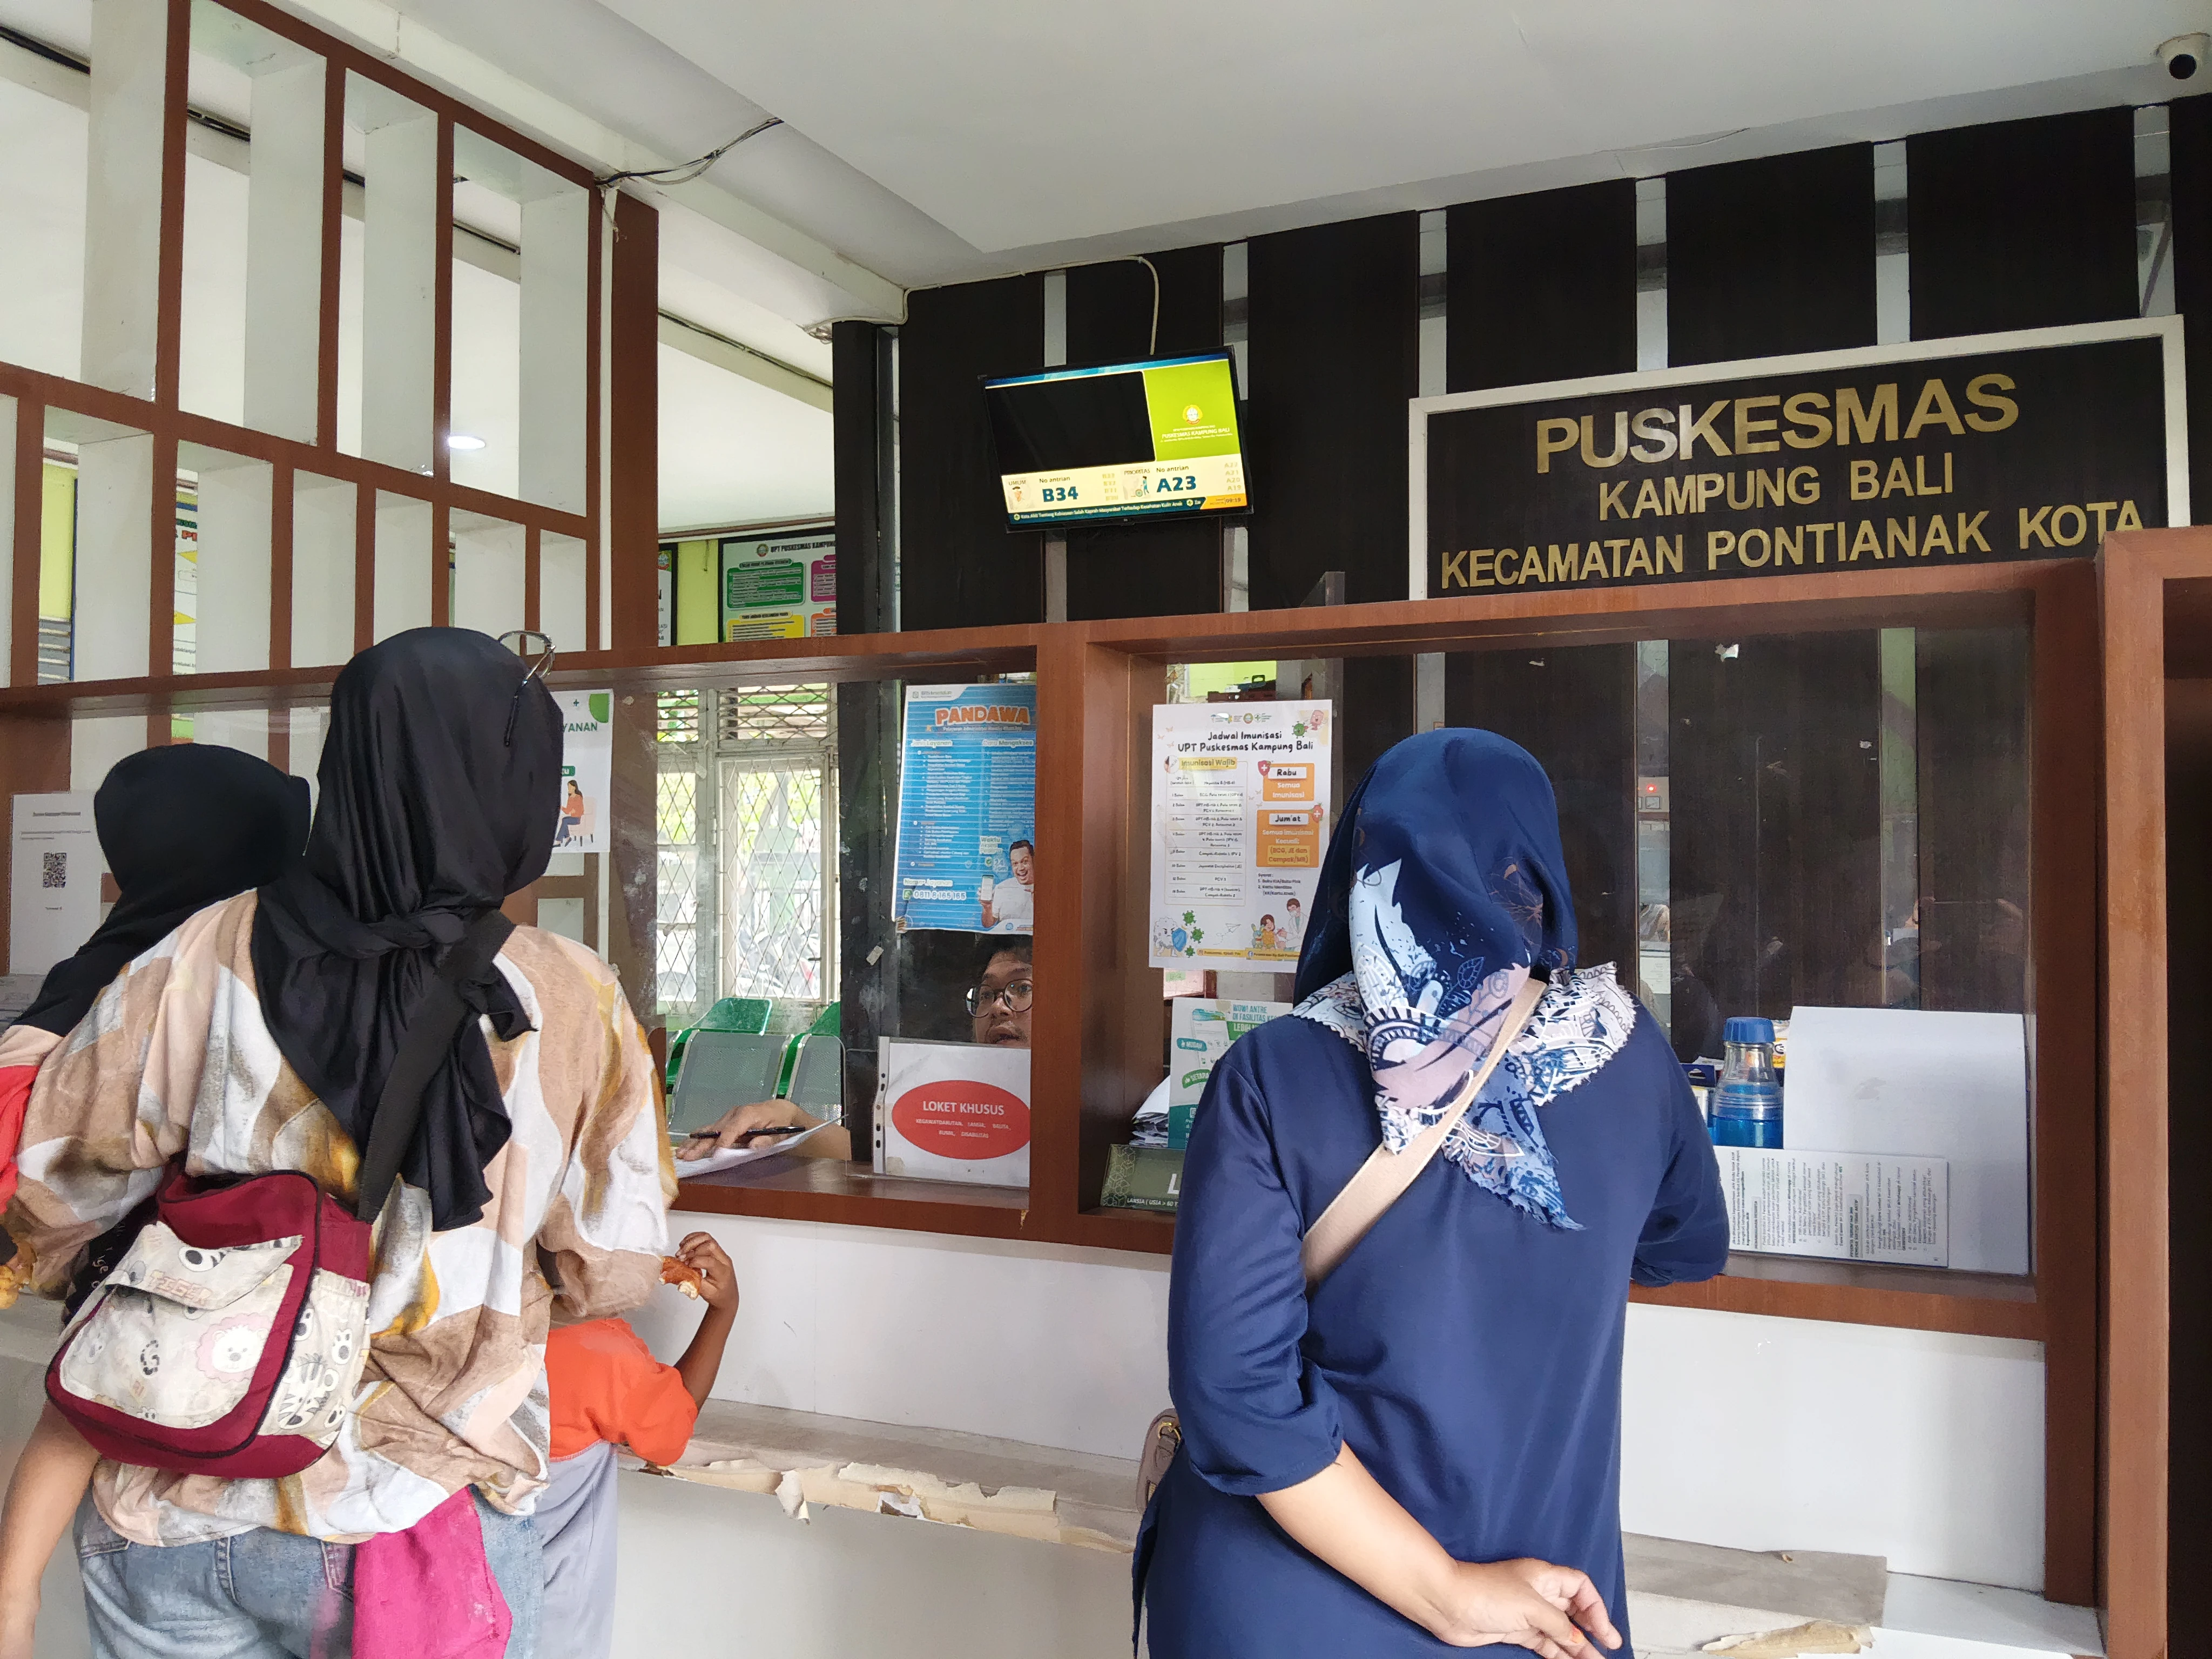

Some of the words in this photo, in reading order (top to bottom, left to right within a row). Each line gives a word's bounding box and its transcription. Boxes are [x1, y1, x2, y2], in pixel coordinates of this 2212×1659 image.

[1536, 373, 2019, 474] PUSKESMAS
[1156, 475, 1197, 493] A23
[1599, 466, 1820, 521] KAMPUNG
[1850, 452, 1953, 501] BALI
[1042, 486, 1079, 502] B34
[1441, 534, 1683, 589] KECAMATAN
[1707, 511, 1992, 571] PONTIANAK
[2019, 500, 2144, 550] KOTA
[935, 705, 1030, 725] PANDAWA
[1208, 731, 1238, 740] Jadwal
[1241, 731, 1282, 739] Imunisasi
[1178, 743, 1197, 752] UPT
[1200, 742, 1249, 752] Puskesmas
[1251, 741, 1293, 753] Kampung
[1296, 740, 1313, 750] Bali
[1215, 758, 1236, 767] Wajib
[1275, 814, 1300, 822] Jum'at
[932, 891, 937, 899] 8
[1249, 1005, 1267, 1014] ANTRE
[1239, 1013, 1266, 1022] FASILITAS
[923, 1100, 957, 1114] LOKET
[960, 1103, 1004, 1115] KHUSUS
